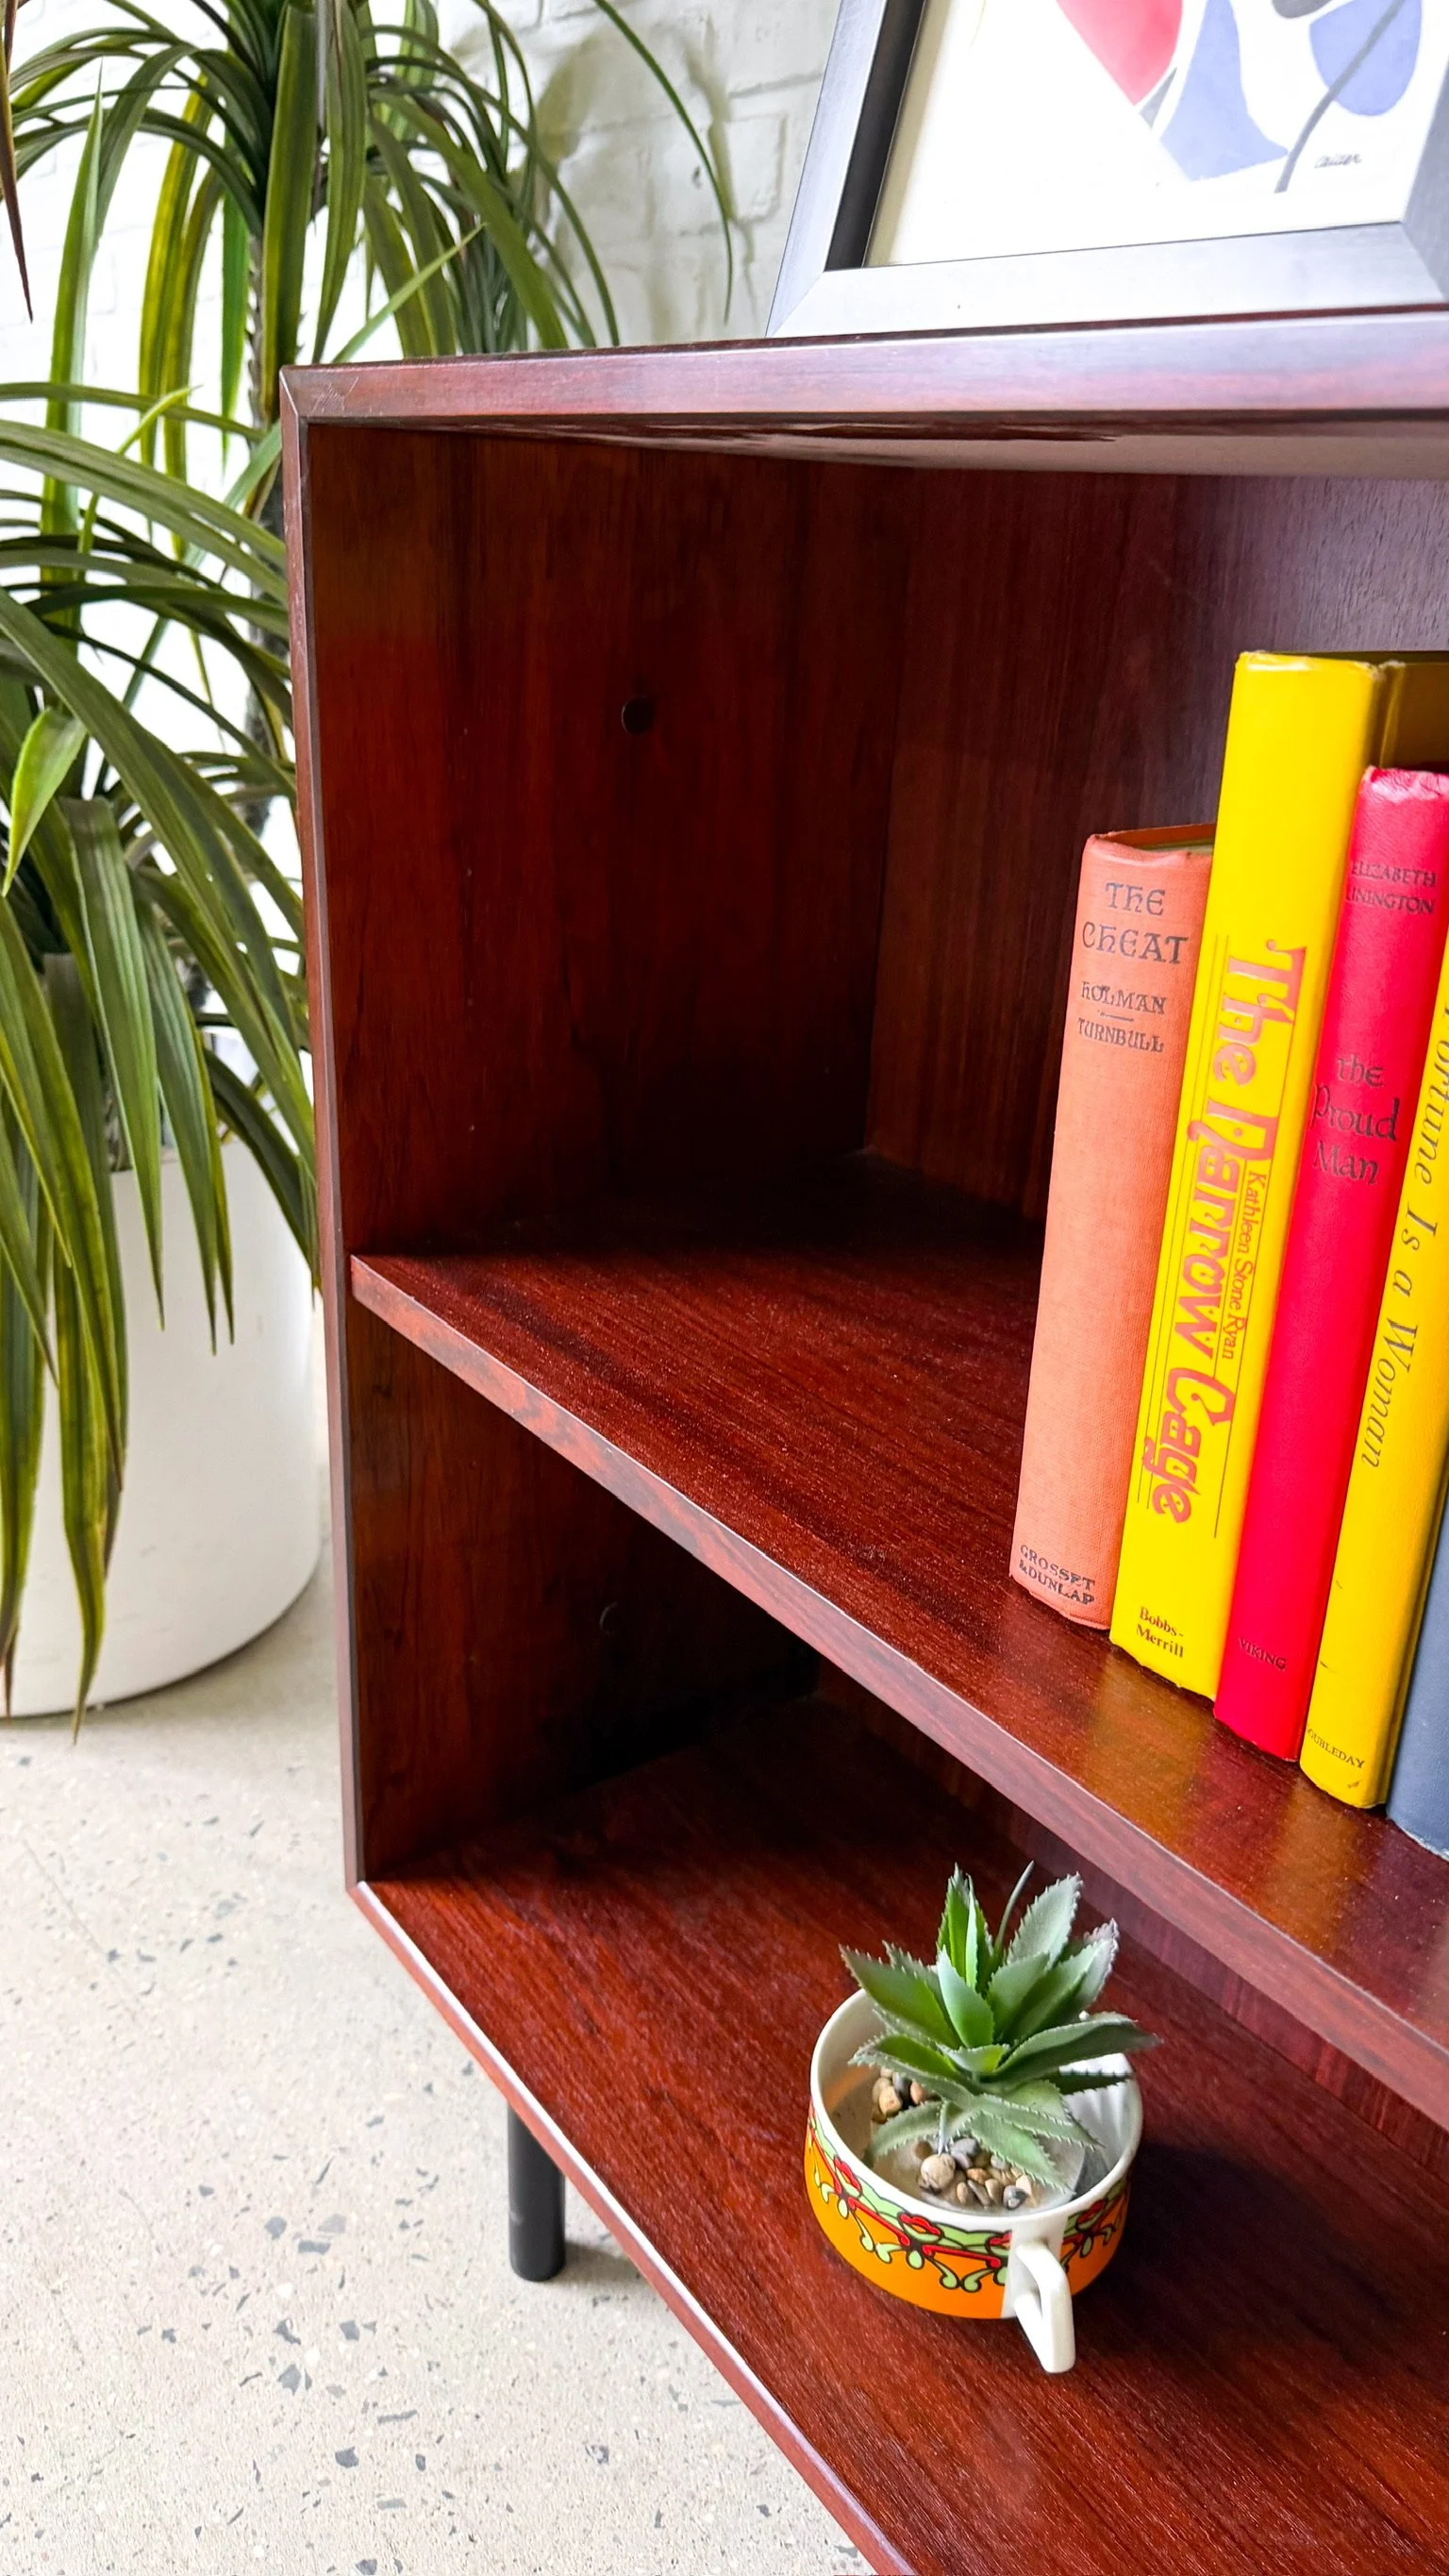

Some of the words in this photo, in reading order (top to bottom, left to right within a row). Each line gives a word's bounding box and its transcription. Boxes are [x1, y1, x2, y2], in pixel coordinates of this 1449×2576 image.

[1351, 860, 1437, 887] ELIZABETH
[1077, 1017, 1165, 1054] TURNBULL
[1213, 939, 1307, 1087] The
[1310, 1082, 1400, 1142] Proud
[1414, 1000, 1449, 1185] ortune
[1312, 1140, 1379, 1185] Man
[1237, 1169, 1268, 1255] Kathleen
[1401, 1201, 1438, 1252] Is
[1229, 1258, 1254, 1311] Stone
[1392, 1269, 1413, 1298] a
[1222, 1313, 1248, 1360] Ryan
[1361, 1317, 1418, 1468] Woman
[1142, 1367, 1236, 1524] Cage
[1020, 1545, 1096, 1592] GROSSET
[1136, 1624, 1185, 1659] Merrill
[1139, 1606, 1185, 1638] Bobbs-
[1238, 1637, 1288, 1672] VIKING
[1307, 1724, 1366, 1770] OUBLEDAY
